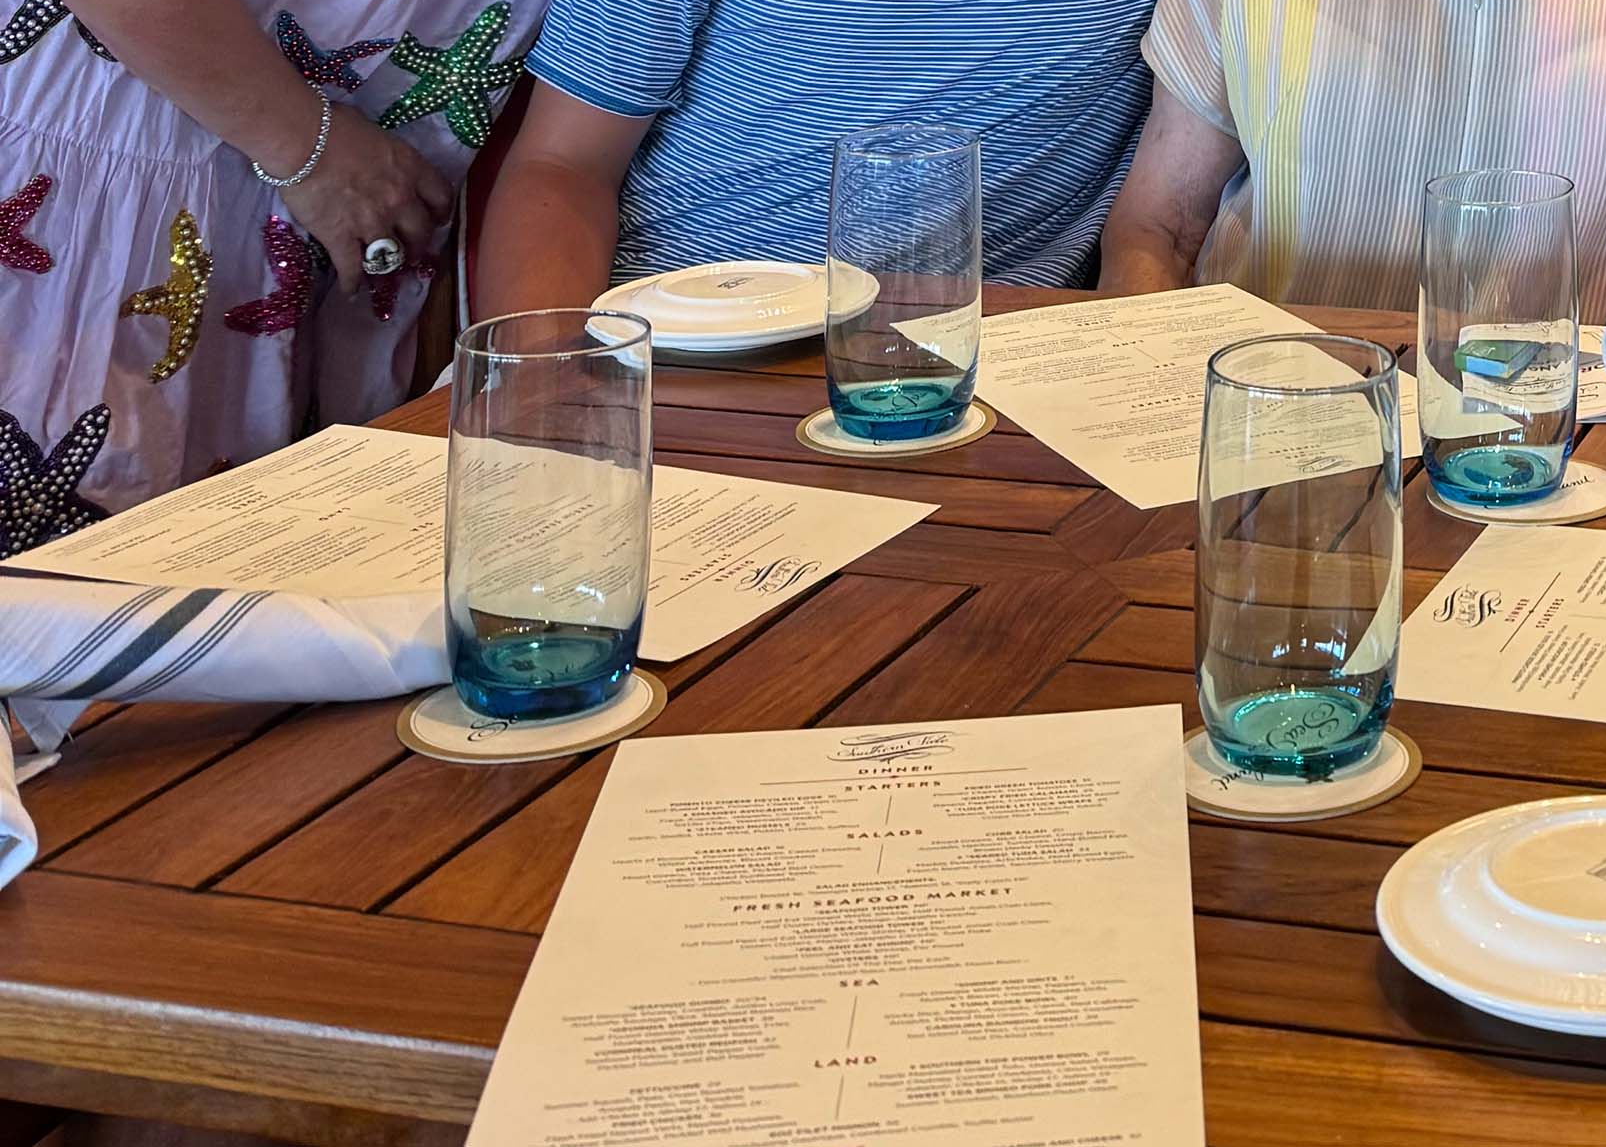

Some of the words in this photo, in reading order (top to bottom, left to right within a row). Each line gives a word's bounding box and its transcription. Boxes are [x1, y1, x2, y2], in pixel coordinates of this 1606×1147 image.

[1535, 598, 1565, 628] STARTERS
[857, 764, 934, 775] DINNER
[844, 780, 942, 793] STARTERS
[847, 829, 923, 839] SALADS
[733, 901, 800, 912] FRESH
[813, 894, 915, 907] SEAFOOD
[927, 887, 1011, 900] MARKET
[839, 978, 879, 988] SEA
[814, 1055, 877, 1068] LAND
